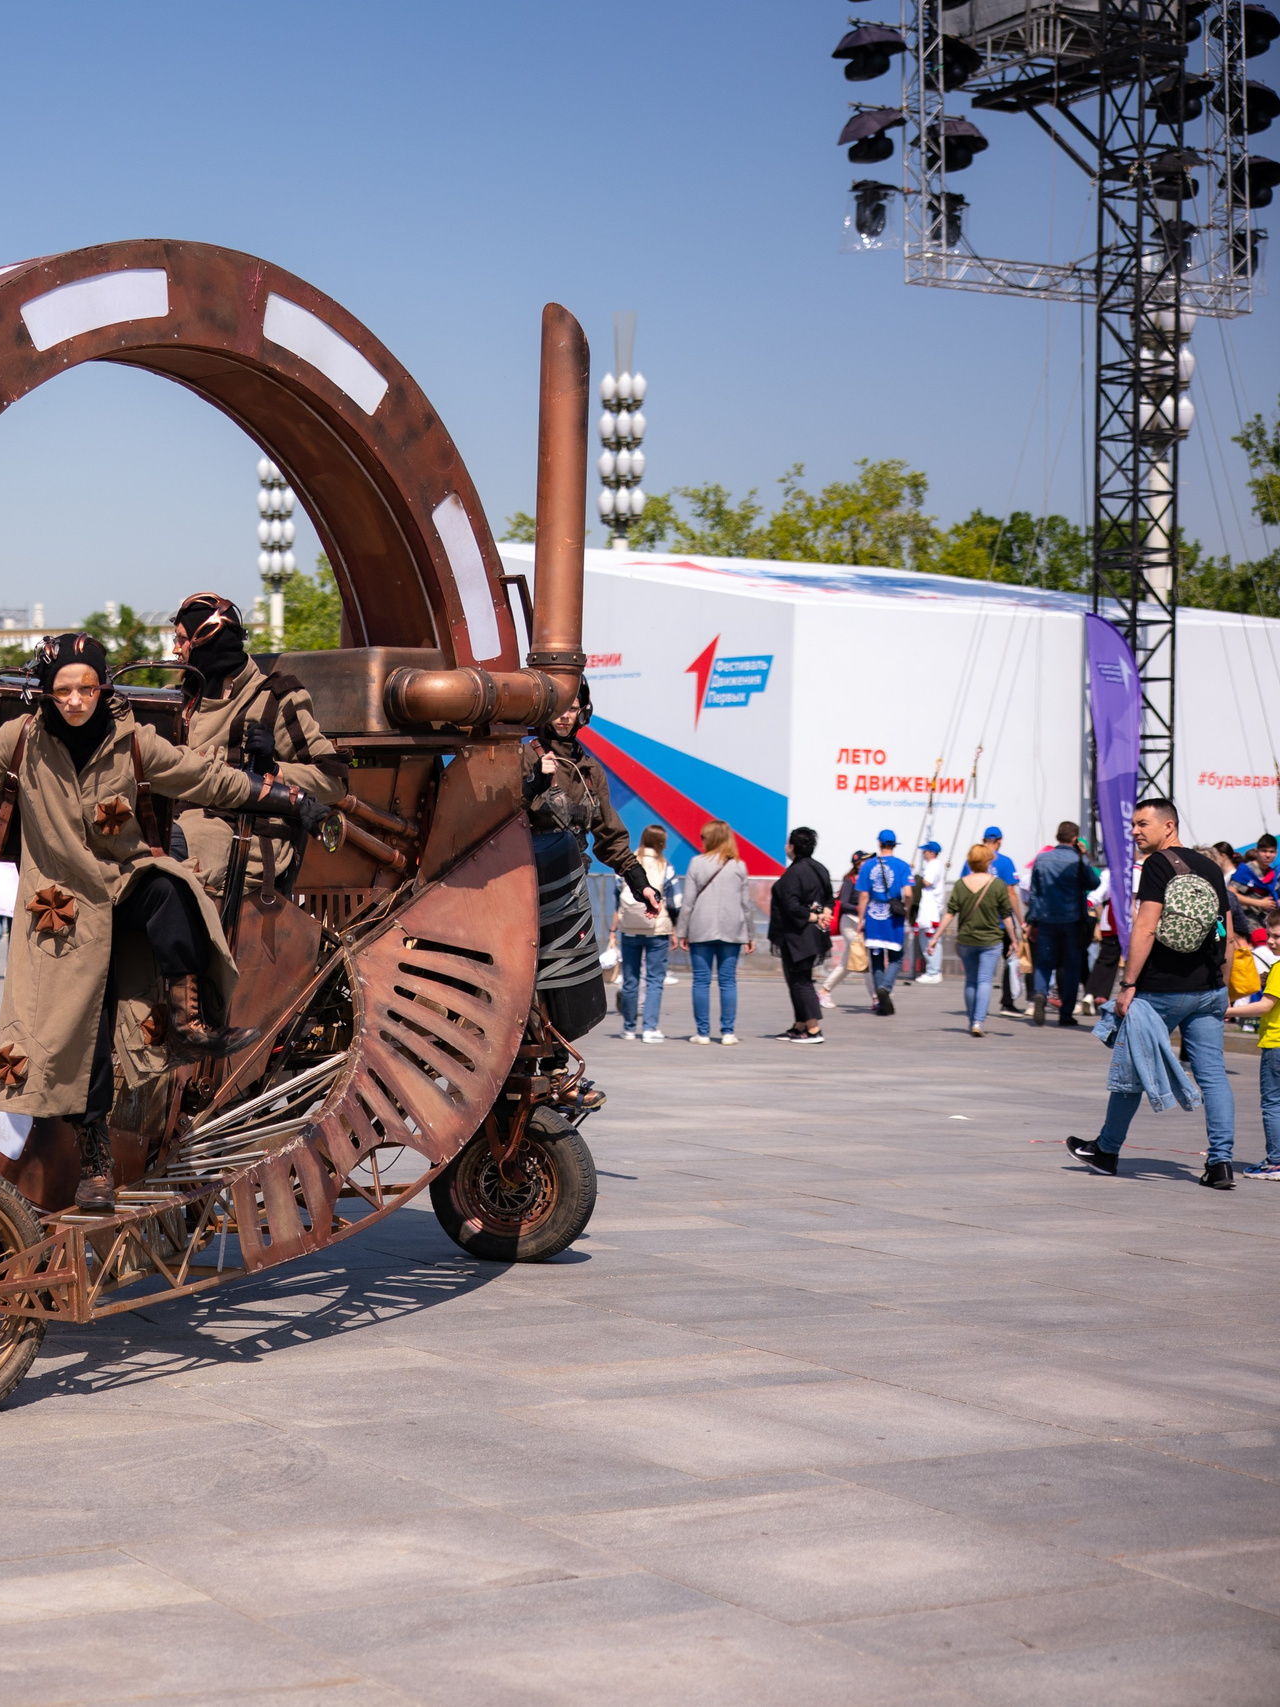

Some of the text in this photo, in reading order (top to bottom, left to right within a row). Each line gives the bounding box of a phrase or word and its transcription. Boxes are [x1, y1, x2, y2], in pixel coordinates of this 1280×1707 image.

[715, 659, 769, 672] Фестиваль
[710, 674, 762, 688] Движения
[706, 690, 747, 705] Первых
[836, 748, 887, 765] ЛЕТО
[836, 774, 966, 794] В ДВИЖЕНИИ
